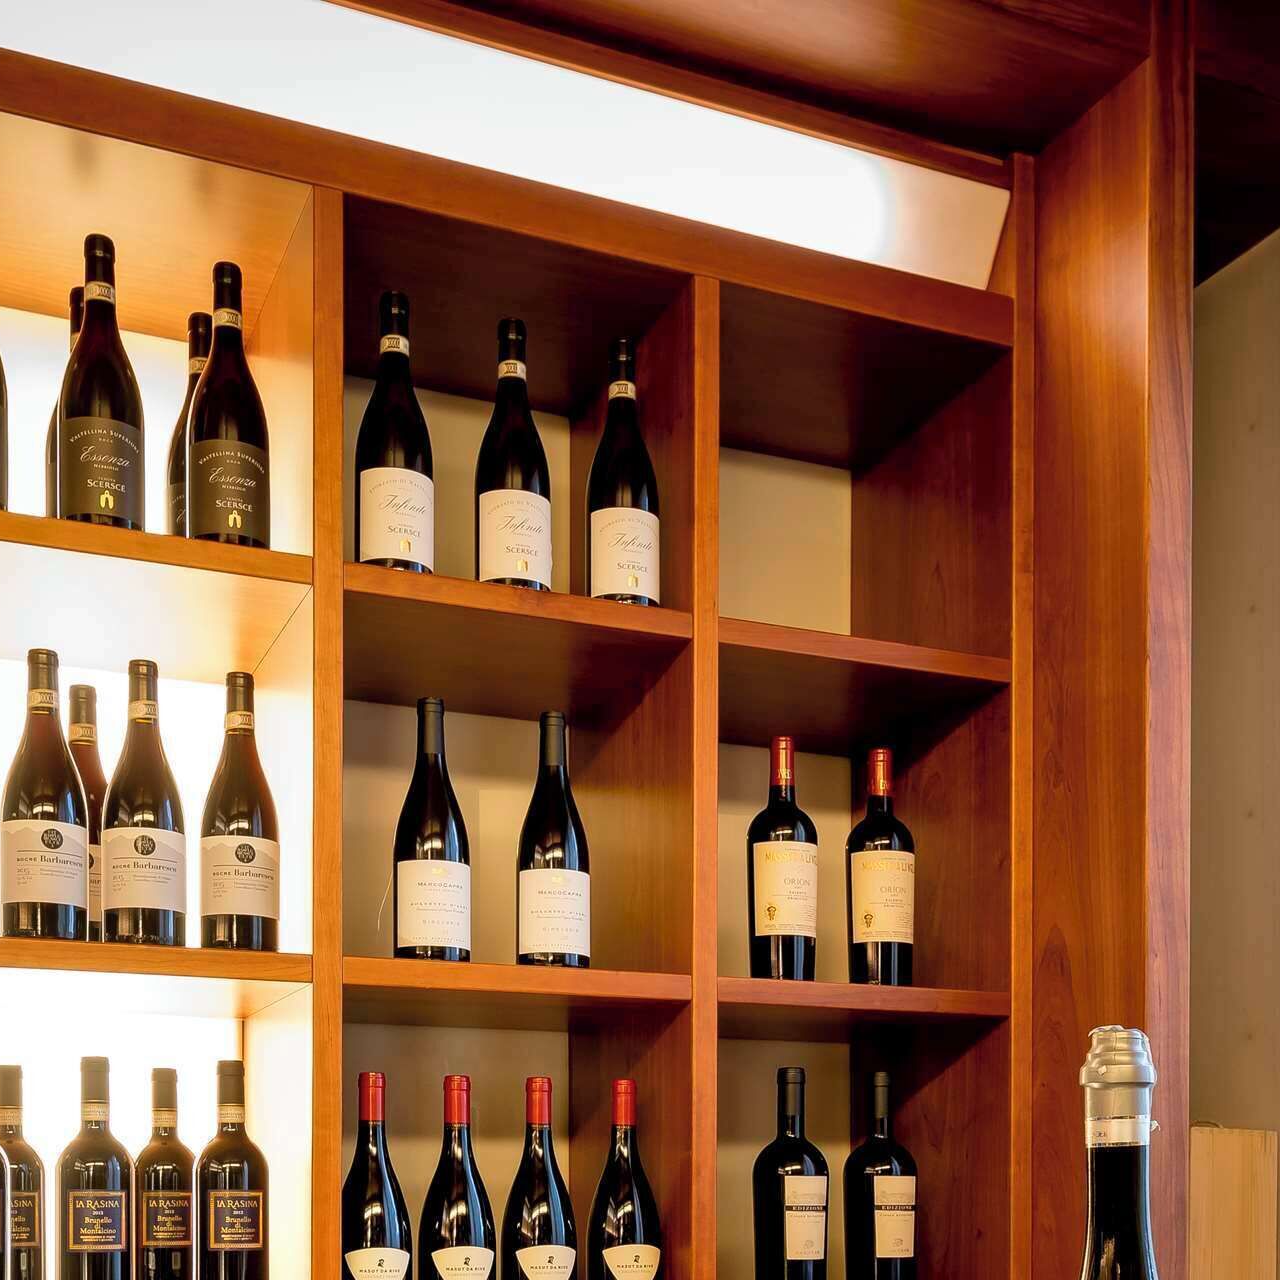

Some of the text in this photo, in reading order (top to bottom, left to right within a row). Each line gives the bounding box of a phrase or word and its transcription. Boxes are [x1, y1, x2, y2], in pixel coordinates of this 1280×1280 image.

[79, 445, 131, 468] Essenza
[208, 466, 257, 487] Essenza
[40, 855, 83, 868] Barbaresco
[133, 861, 177, 872] Barbaresco
[234, 869, 274, 880] Barbaresco
[86, 1199, 120, 1210] RASINA
[79, 1227, 117, 1235] Montalcino
